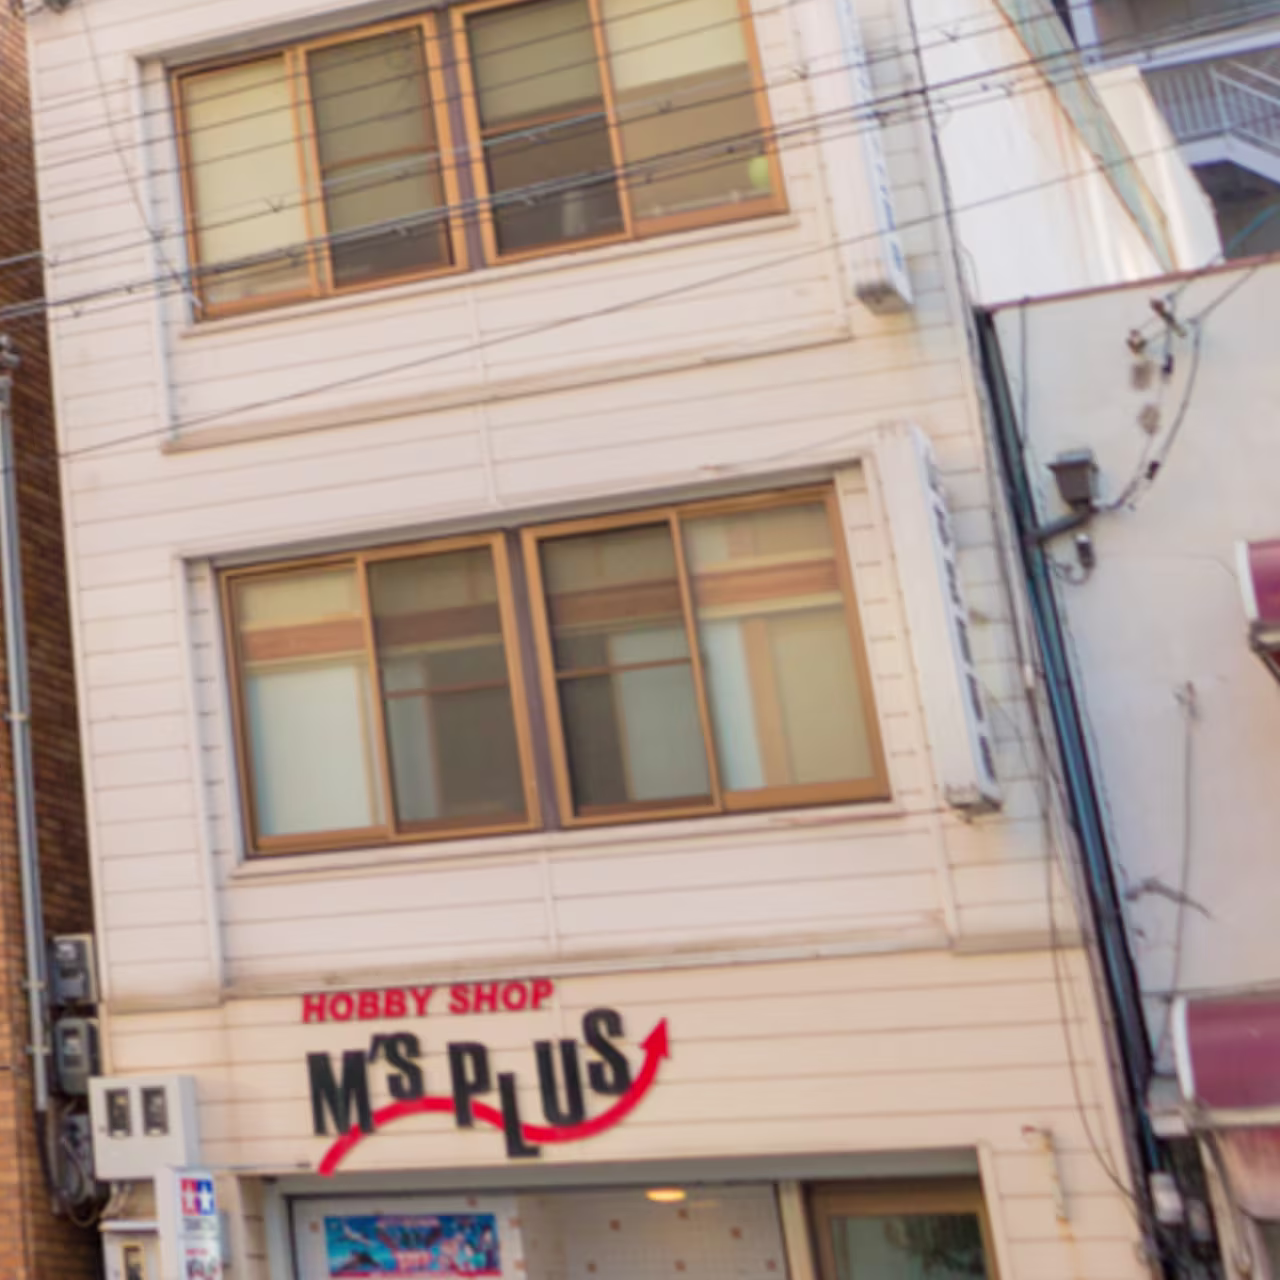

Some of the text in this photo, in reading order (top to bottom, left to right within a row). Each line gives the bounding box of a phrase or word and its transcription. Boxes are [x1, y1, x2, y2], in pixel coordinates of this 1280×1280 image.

[301, 978, 555, 1024] HOBBY SHOP
[447, 1007, 632, 1158] PLUS
